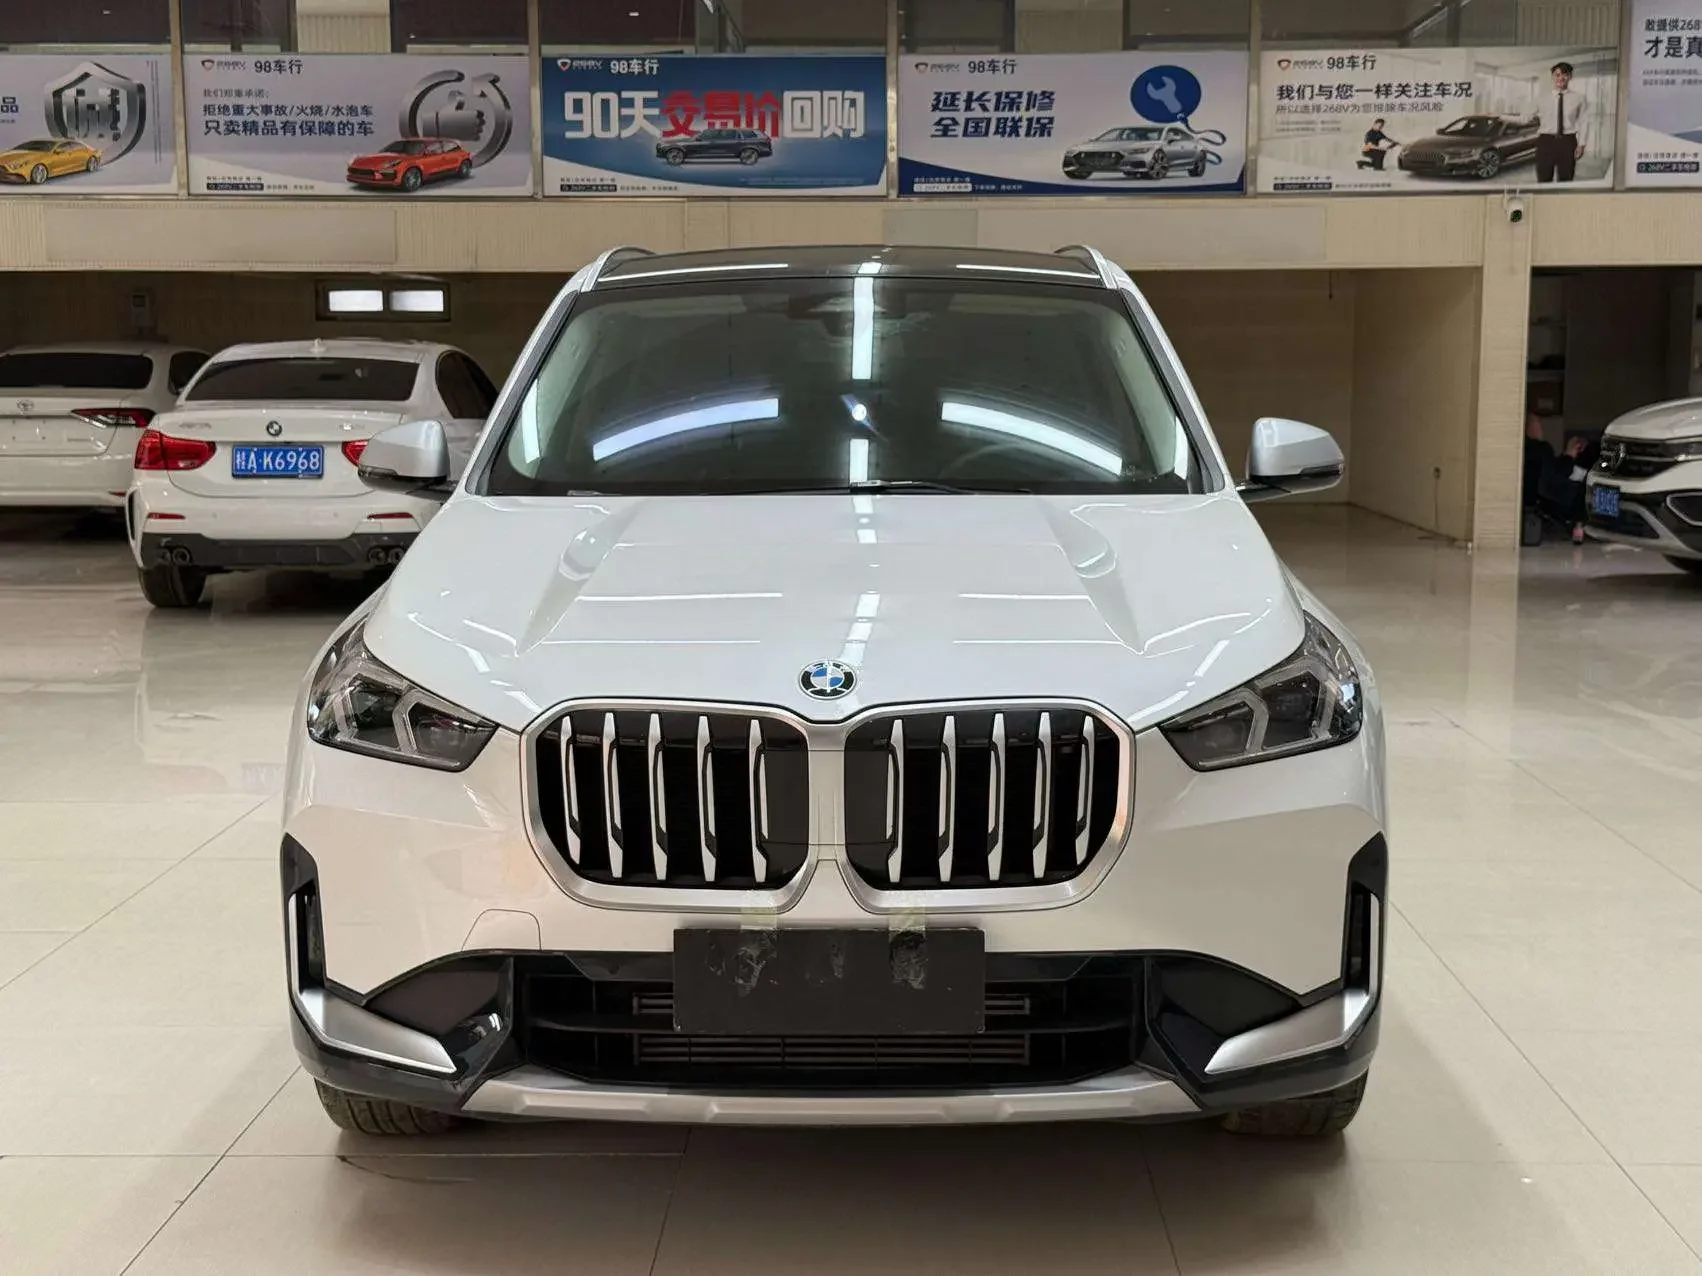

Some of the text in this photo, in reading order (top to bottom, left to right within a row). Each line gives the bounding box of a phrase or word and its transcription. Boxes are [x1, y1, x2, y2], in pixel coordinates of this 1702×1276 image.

[1645, 36, 1702, 58] 才是真
[254, 59, 303, 75] 98车行
[610, 59, 660, 75] 98车行
[968, 59, 1017, 75] 98车行
[1326, 55, 1376, 71] 98车行
[1276, 82, 1473, 101] 我们与您一样关注车况
[931, 90, 1056, 112] 延长保修
[203, 104, 374, 117] 拒绝重大事故/火烧/水泡车
[564, 90, 864, 140] 90天交易价回购
[204, 119, 375, 136] 只卖精品有保障的车
[930, 116, 1055, 138] 全国联保
